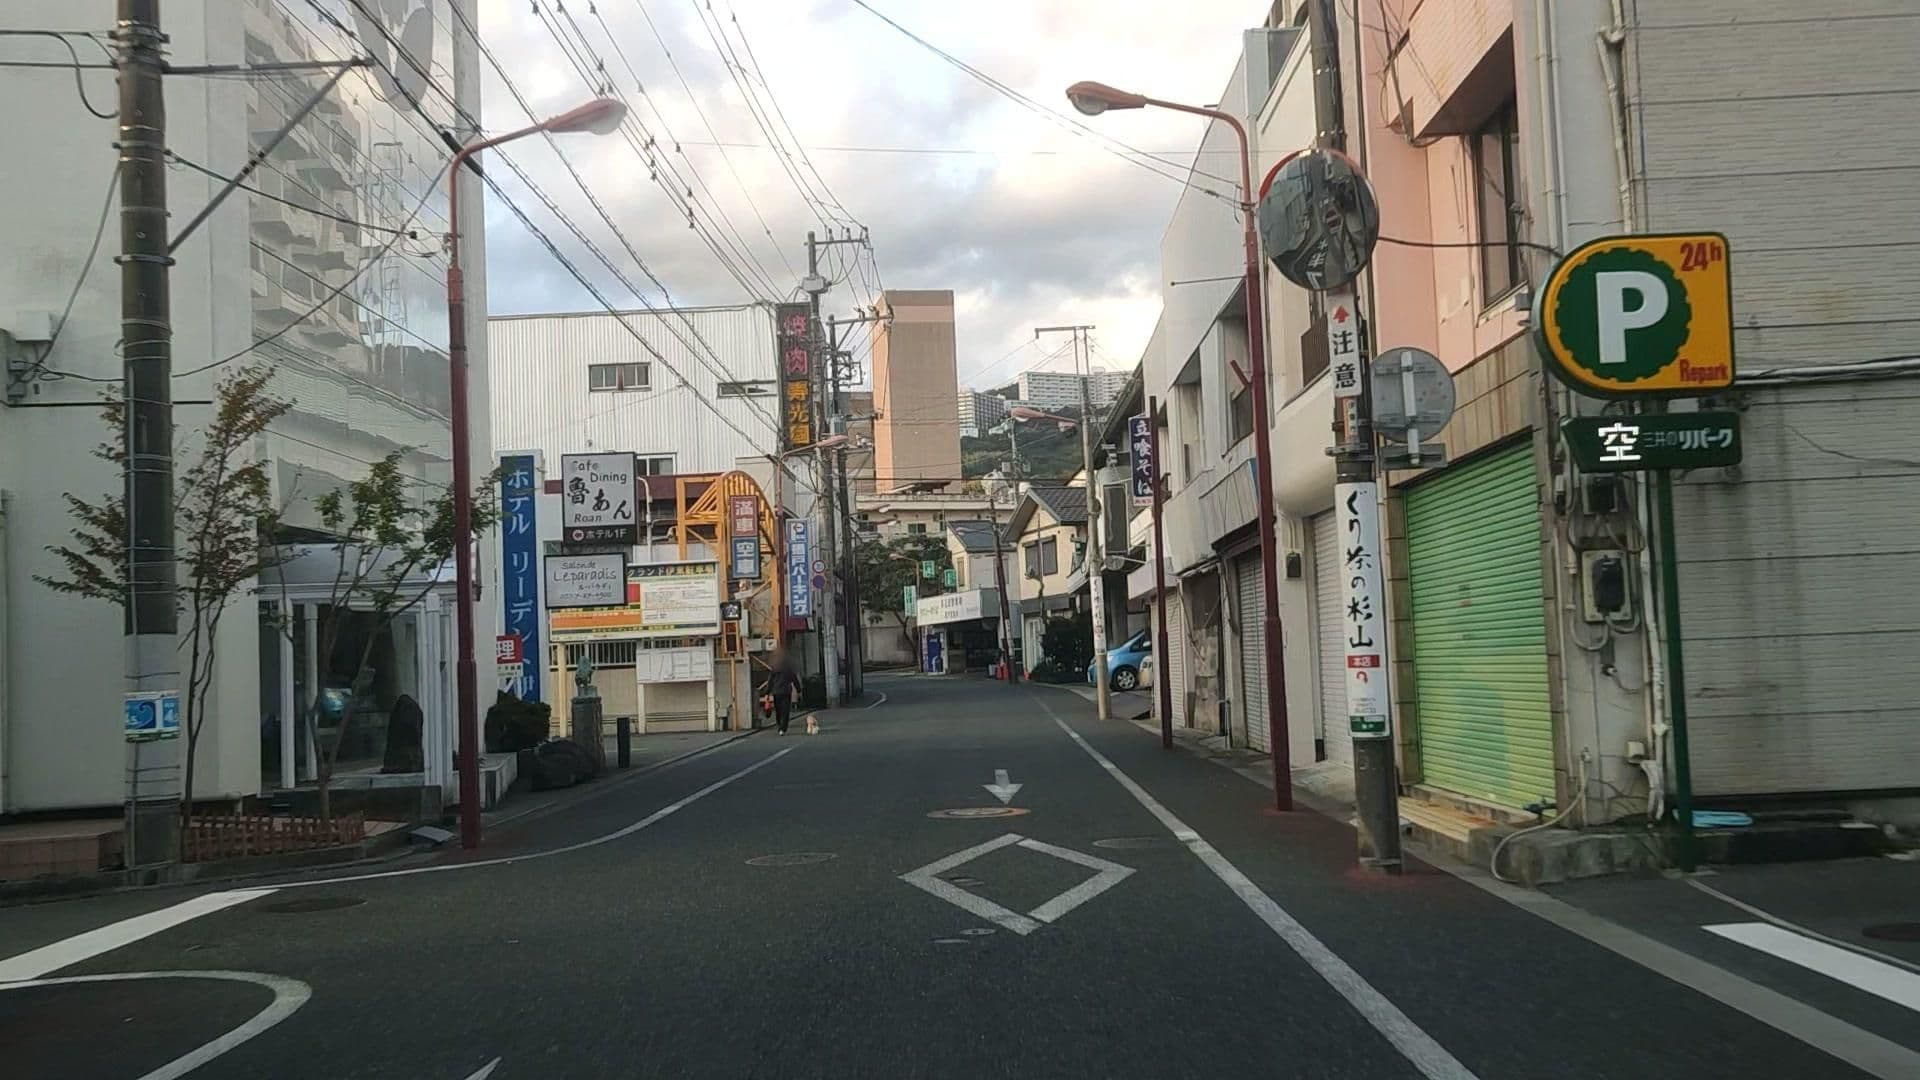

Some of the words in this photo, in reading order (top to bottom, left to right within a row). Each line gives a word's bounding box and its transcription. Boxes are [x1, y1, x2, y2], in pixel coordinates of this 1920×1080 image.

[1679, 242, 1722, 272] 24h
[1596, 271, 1669, 364] P
[1332, 330, 1356, 389] 注意
[1679, 359, 1729, 384] Repark
[1598, 422, 1641, 462] 空
[590, 472, 627, 485] Dining
[574, 513, 602, 523] Roan
